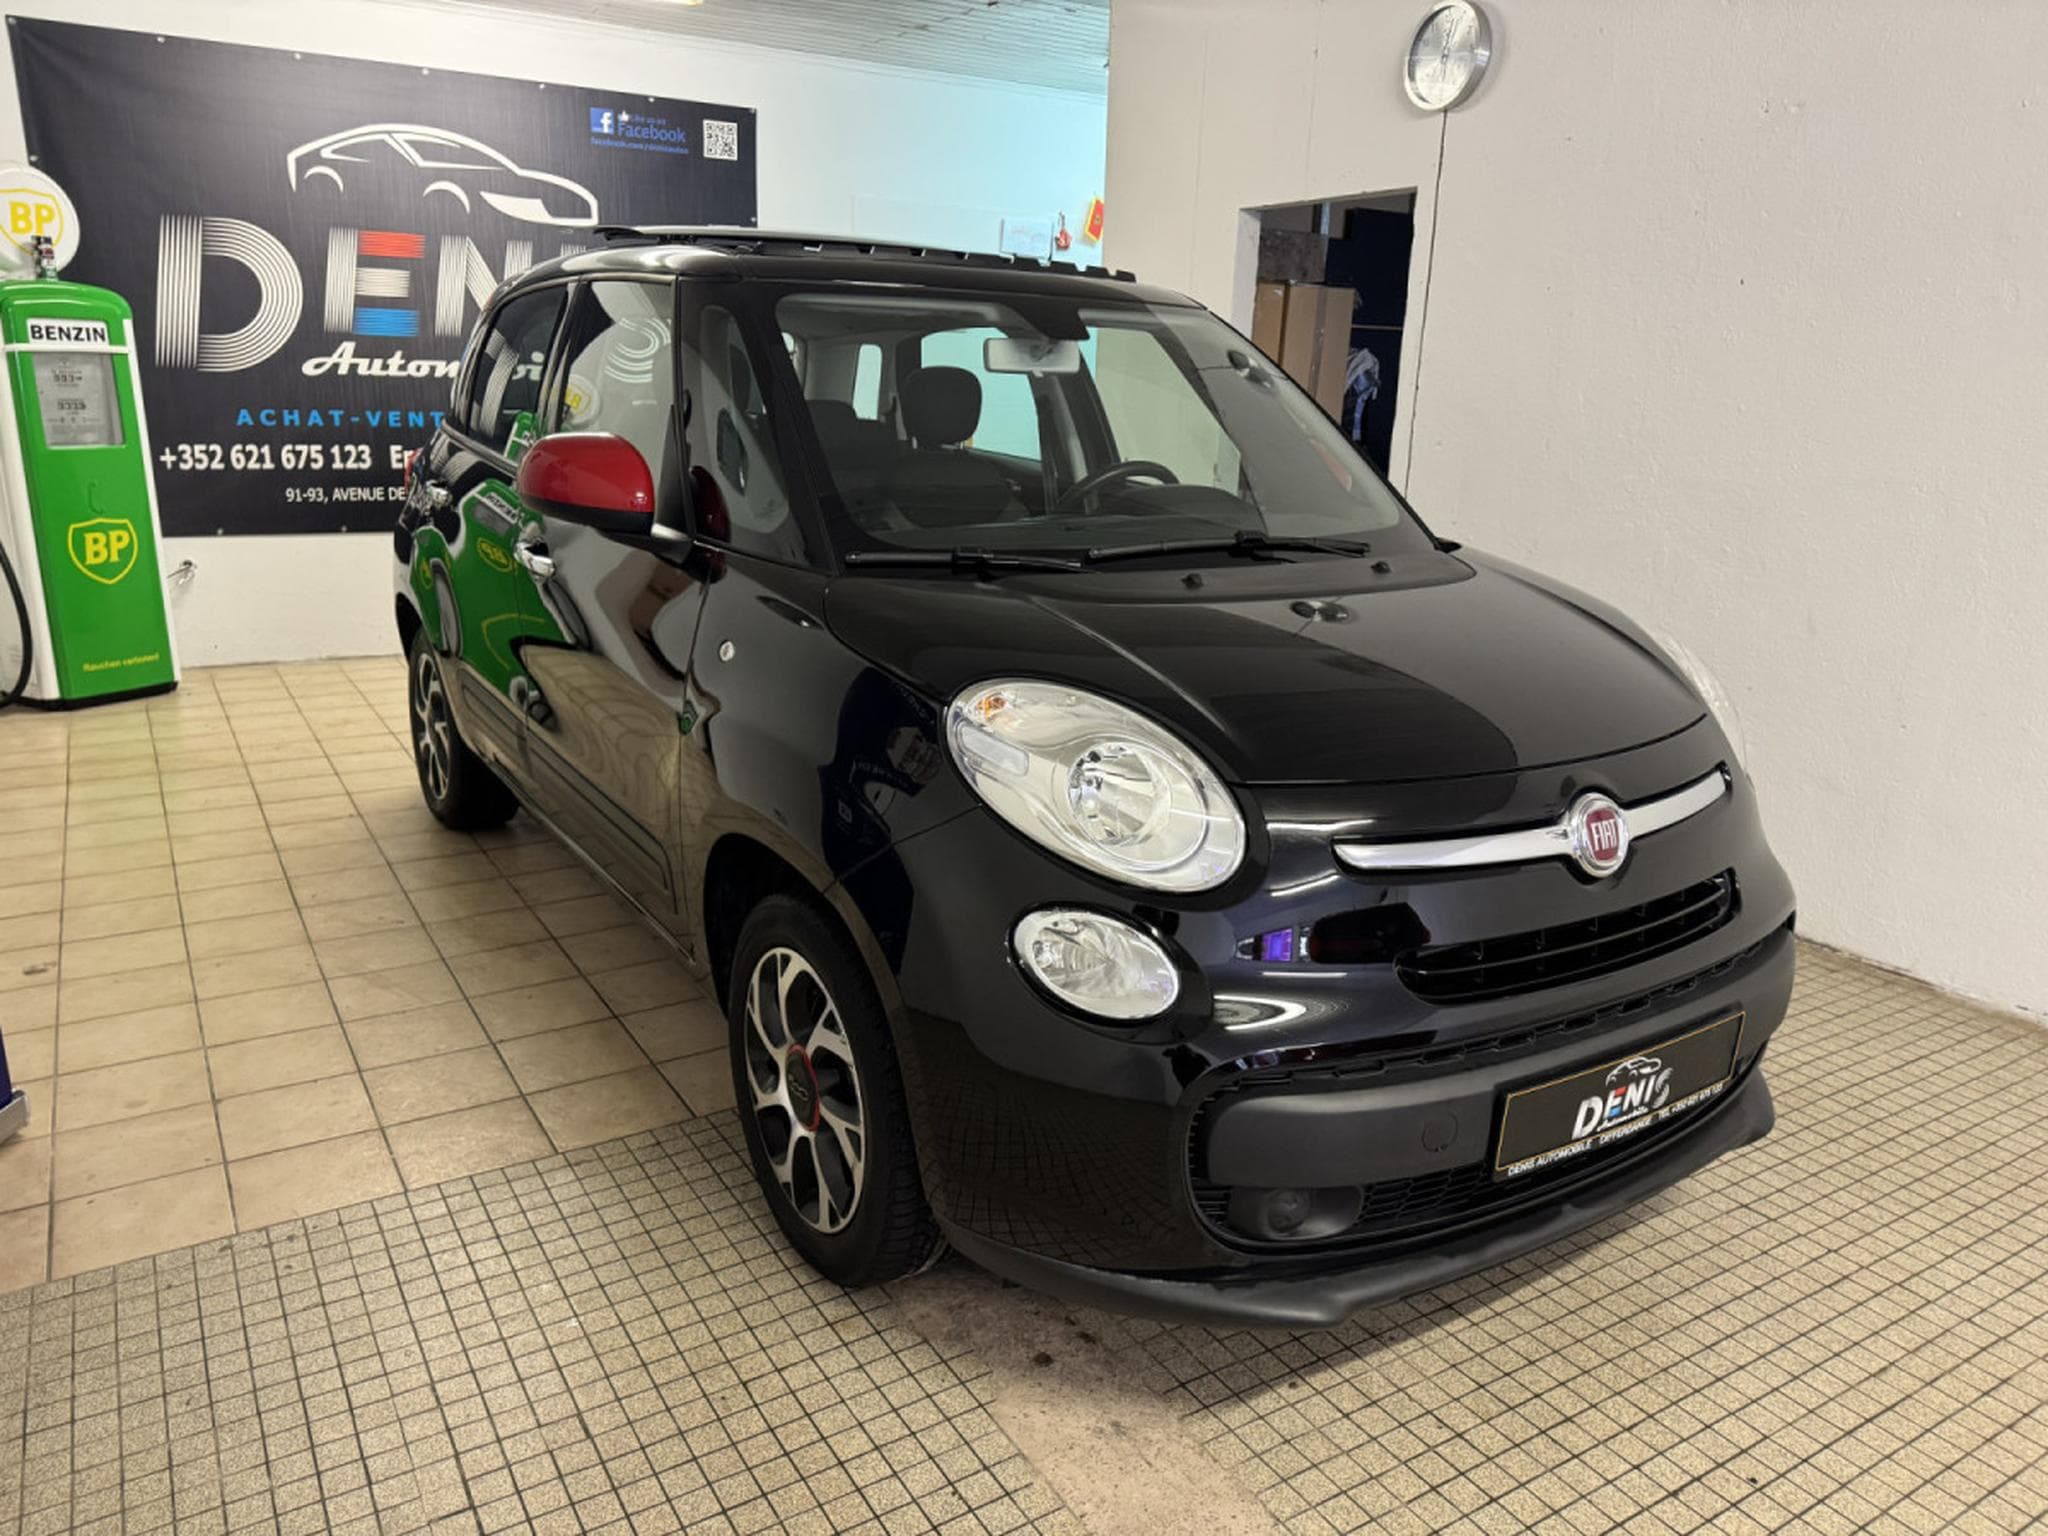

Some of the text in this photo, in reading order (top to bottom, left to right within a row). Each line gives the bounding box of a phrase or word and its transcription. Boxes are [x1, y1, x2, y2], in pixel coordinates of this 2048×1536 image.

[617, 122, 687, 143] Facebook
[9, 201, 56, 236] BP
[155, 213, 588, 372] DEN
[30, 324, 107, 342] BENZIN
[160, 443, 225, 470] +352
[230, 444, 274, 470] 621
[281, 444, 325, 470] 675
[331, 444, 372, 470] 123
[285, 486, 329, 504] 91-93,
[332, 487, 385, 501] AVENUE
[84, 530, 131, 566] BP
[1590, 818, 1618, 852] FIAT
[1571, 1066, 1674, 1140] DENIS
